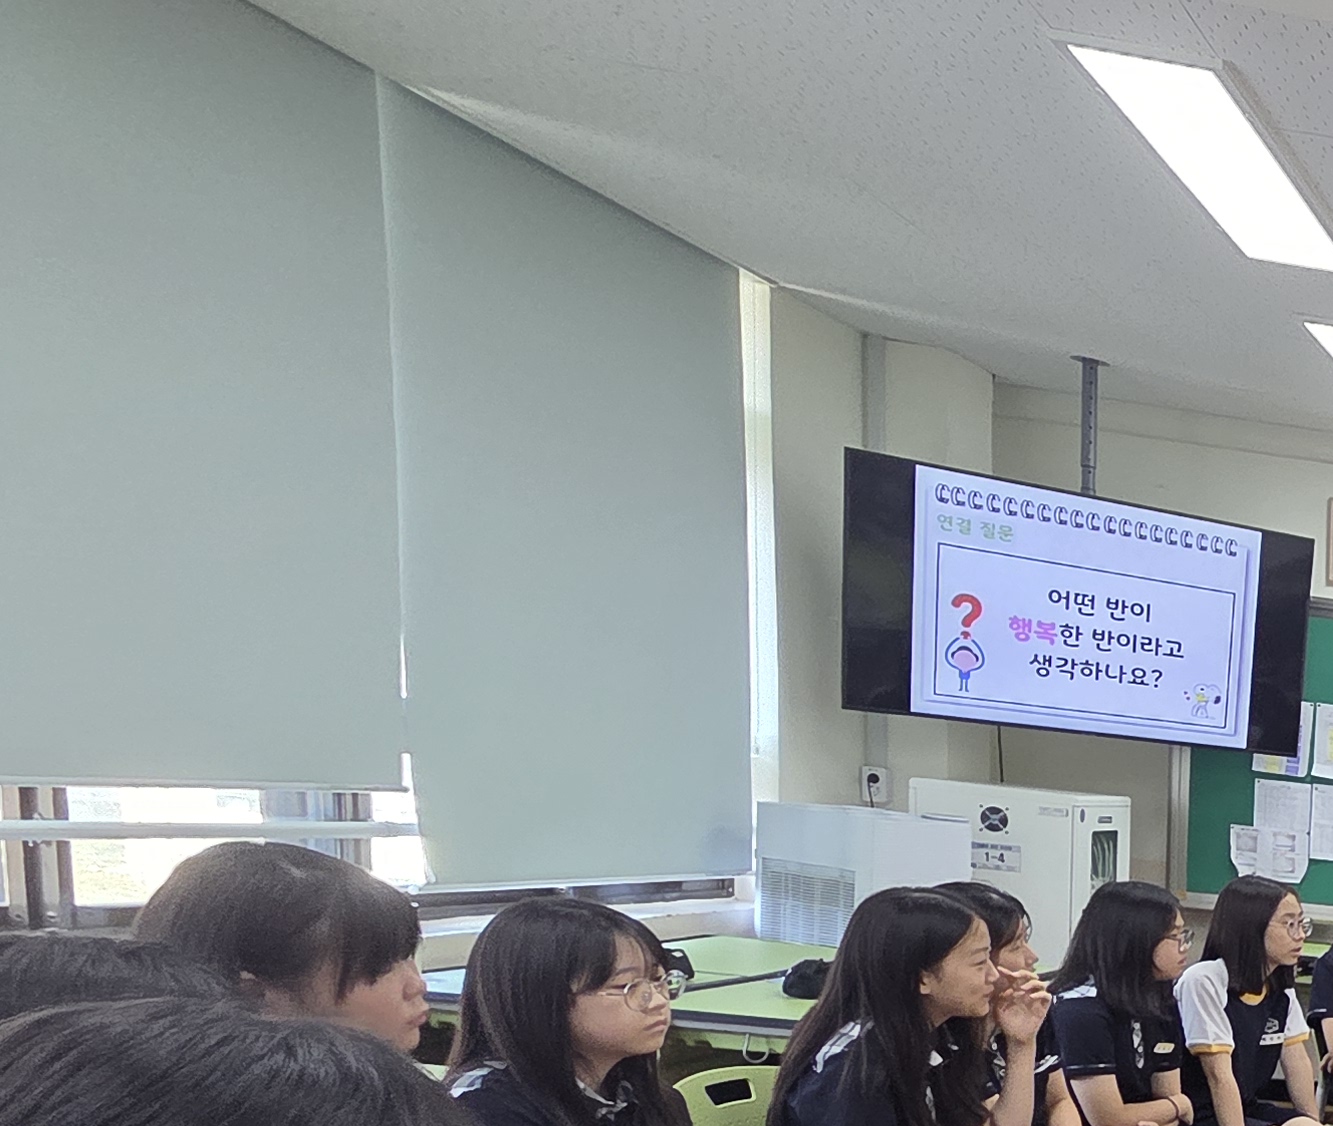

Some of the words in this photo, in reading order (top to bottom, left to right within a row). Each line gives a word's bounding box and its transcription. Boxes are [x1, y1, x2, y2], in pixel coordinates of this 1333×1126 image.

[937, 513, 971, 534] 연결
[980, 521, 1014, 542] 질문
[1048, 589, 1095, 616] 어떤
[1106, 597, 1151, 622] 반이
[1009, 615, 1083, 647] 행복한
[1092, 629, 1184, 659] 반이라고
[1029, 653, 1163, 688] 생각하나요?
[984, 851, 1006, 863] 1-4
